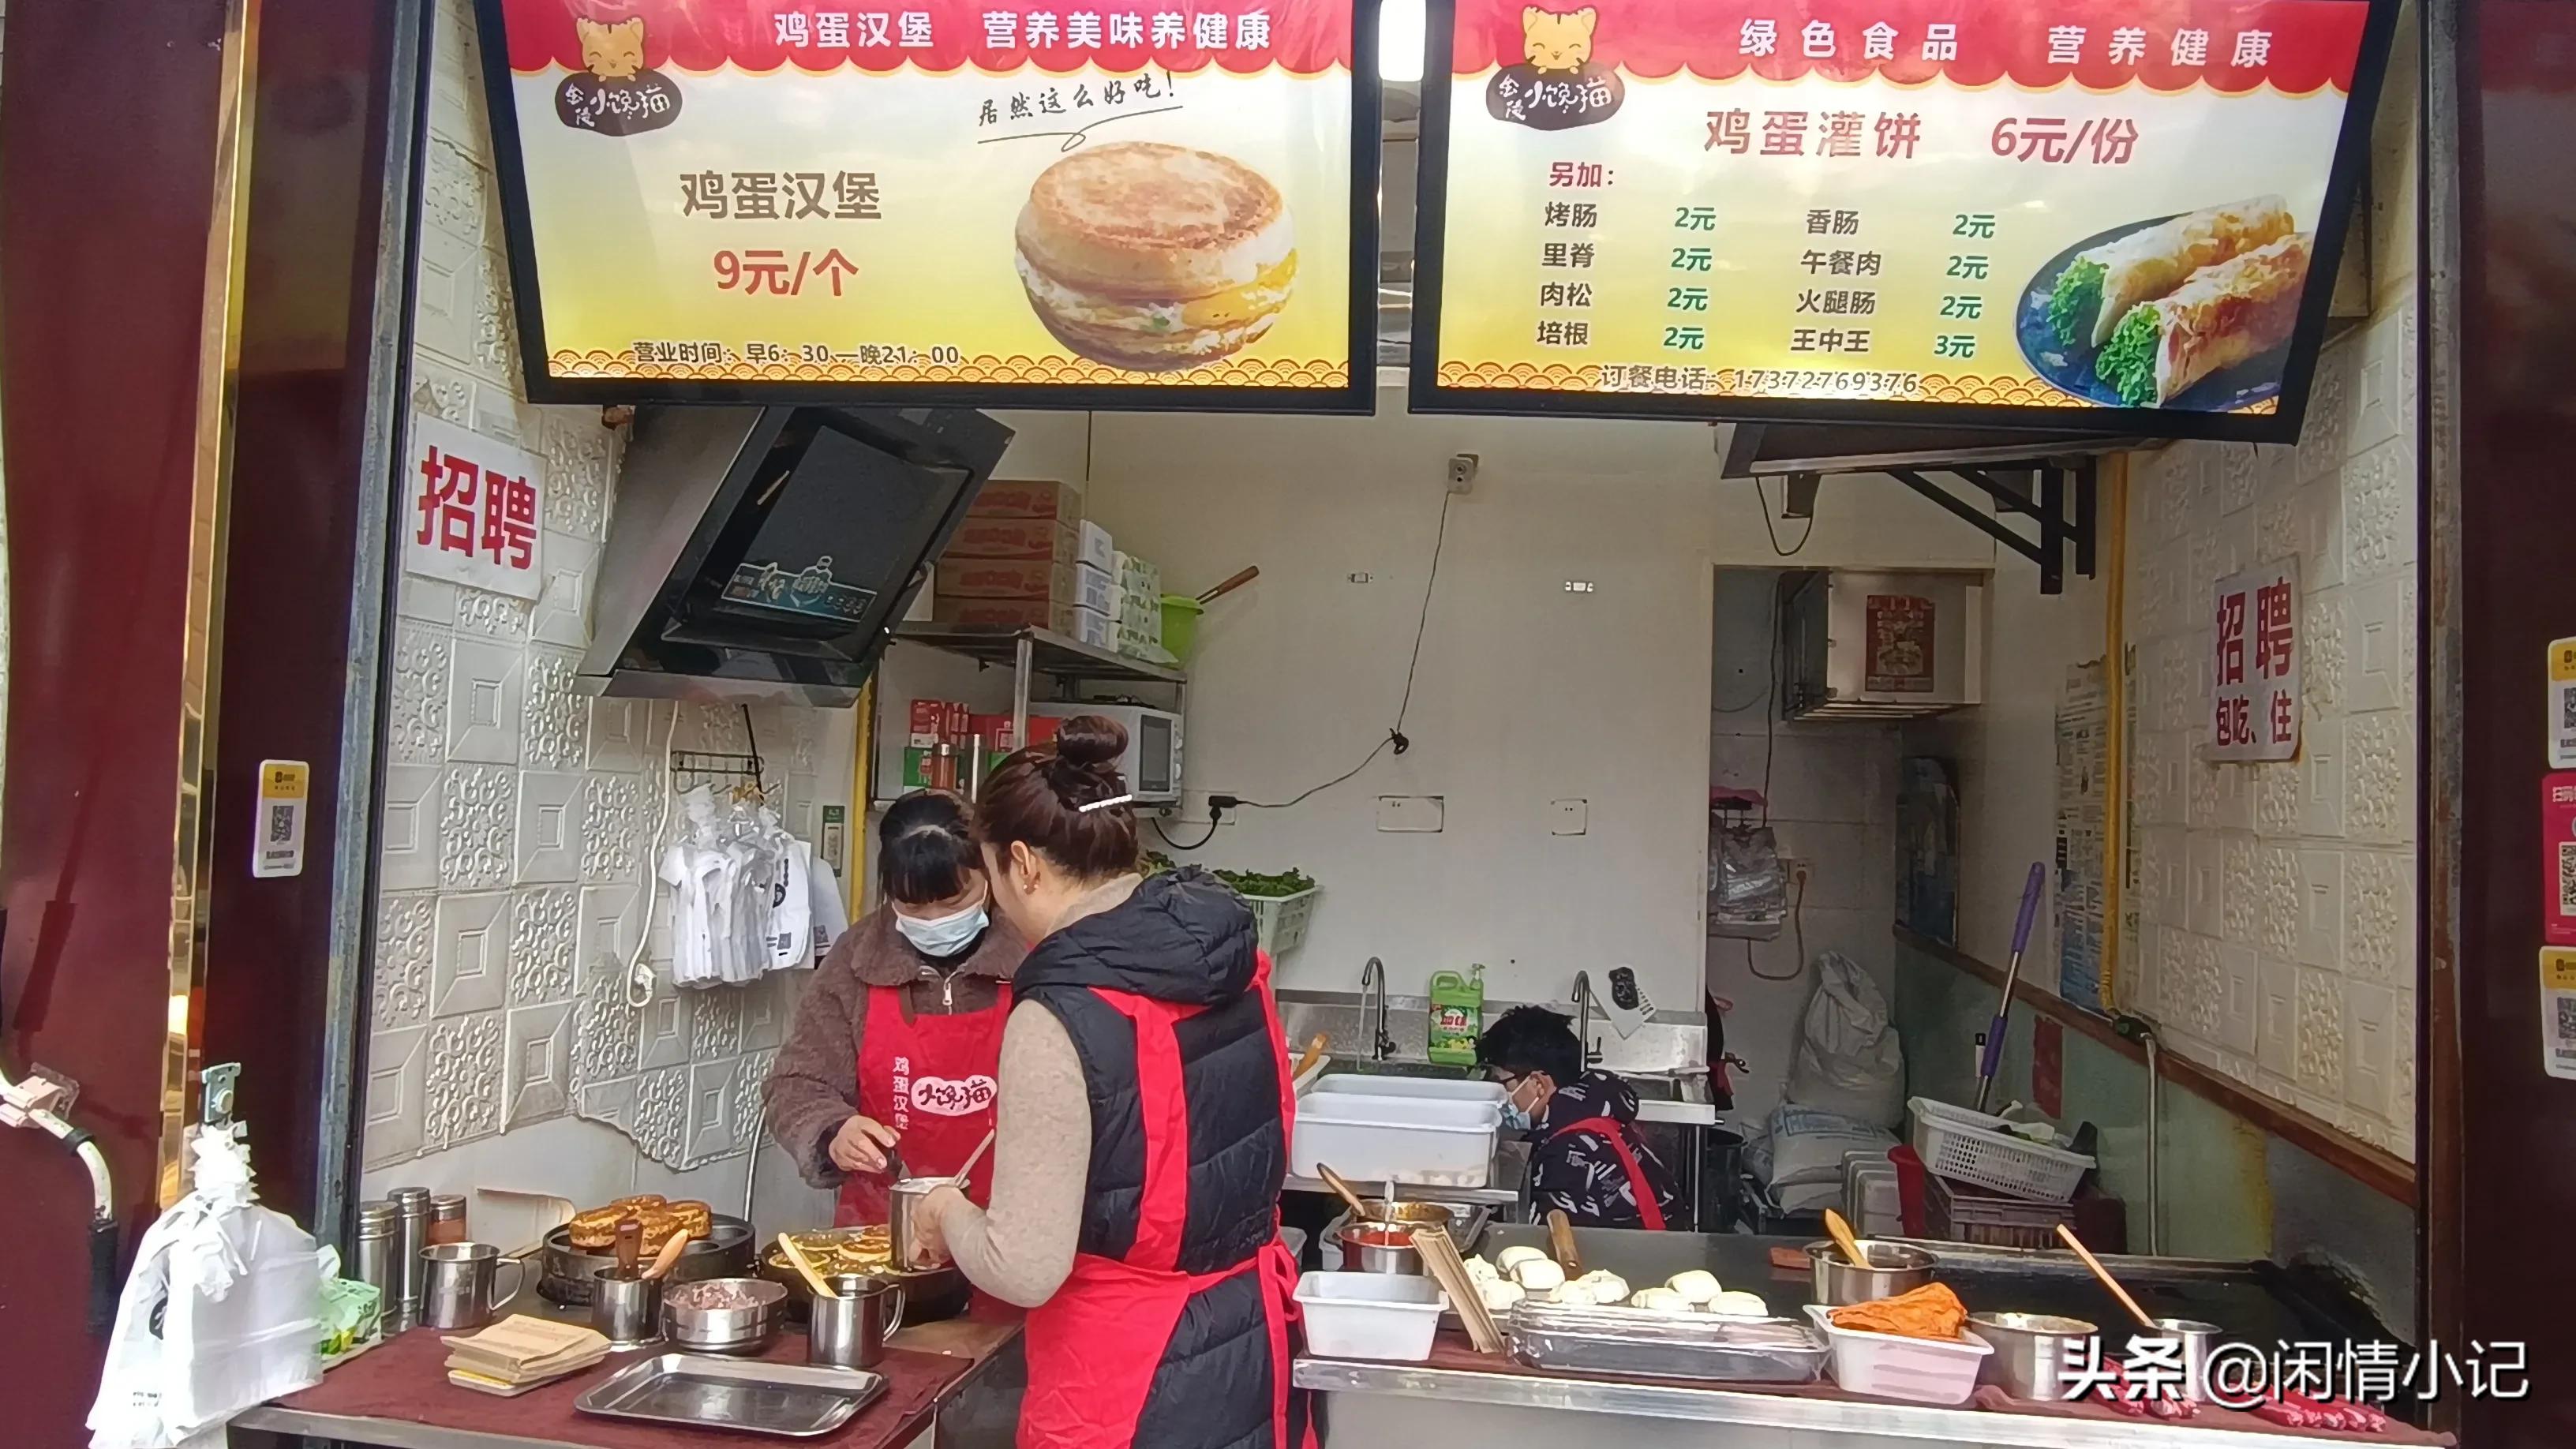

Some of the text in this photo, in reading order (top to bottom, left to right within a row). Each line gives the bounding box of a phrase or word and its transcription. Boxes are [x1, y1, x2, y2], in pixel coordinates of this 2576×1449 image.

[774, 11, 1271, 50] 鸡蛋汉堡 营养美味养健康
[1739, 18, 2273, 68] 绿色食品 营养健康
[1704, 108, 2140, 164] 鸡蛋灌饼 6元/份
[680, 169, 882, 220] 鸡蛋汉堡
[1544, 202, 1996, 239] 烤肠 2元 香肠 2元
[713, 248, 859, 297] 9元/个
[1541, 242, 1989, 280] 里脊 2元 午餐肉 2元
[1539, 282, 1983, 320] 肉松 2元 火腿肠 2元
[1537, 320, 1975, 358] 培根 2元 王中王 3元
[416, 444, 537, 570] 招聘
[2216, 575, 2293, 687] 招聘
